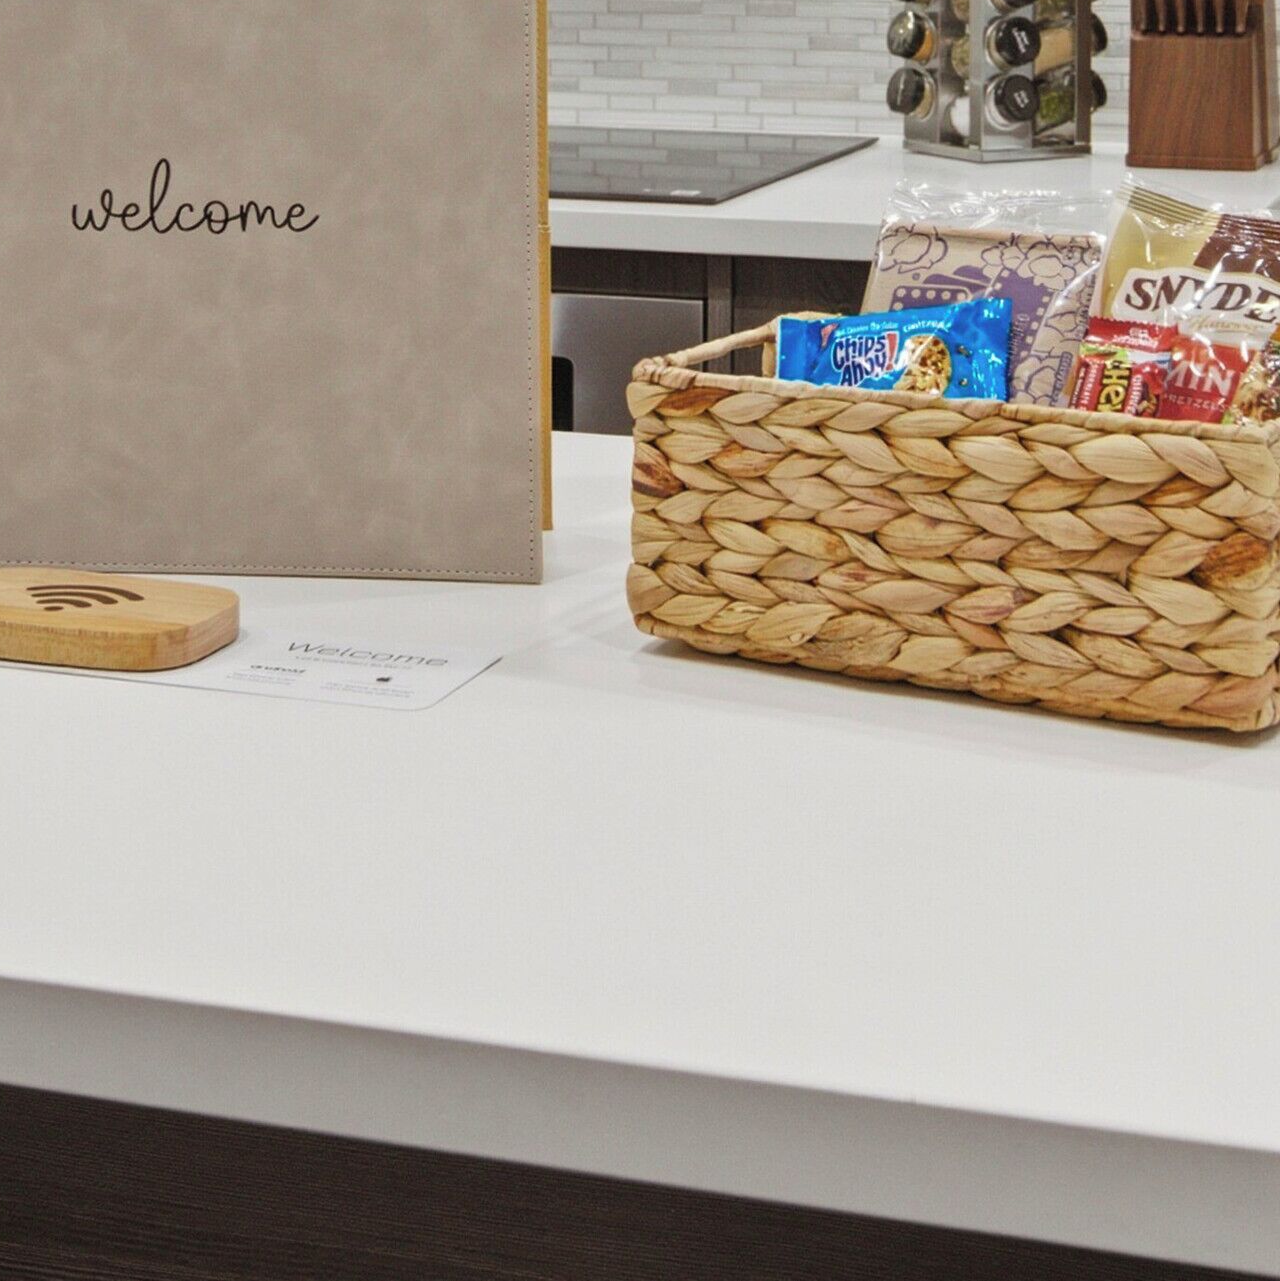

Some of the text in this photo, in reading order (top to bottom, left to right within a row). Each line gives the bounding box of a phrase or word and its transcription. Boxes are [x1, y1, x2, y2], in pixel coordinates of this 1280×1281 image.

[71, 157, 320, 234] welcome
[1163, 392, 1227, 413] RETZELS
[288, 641, 449, 667] Welcome
